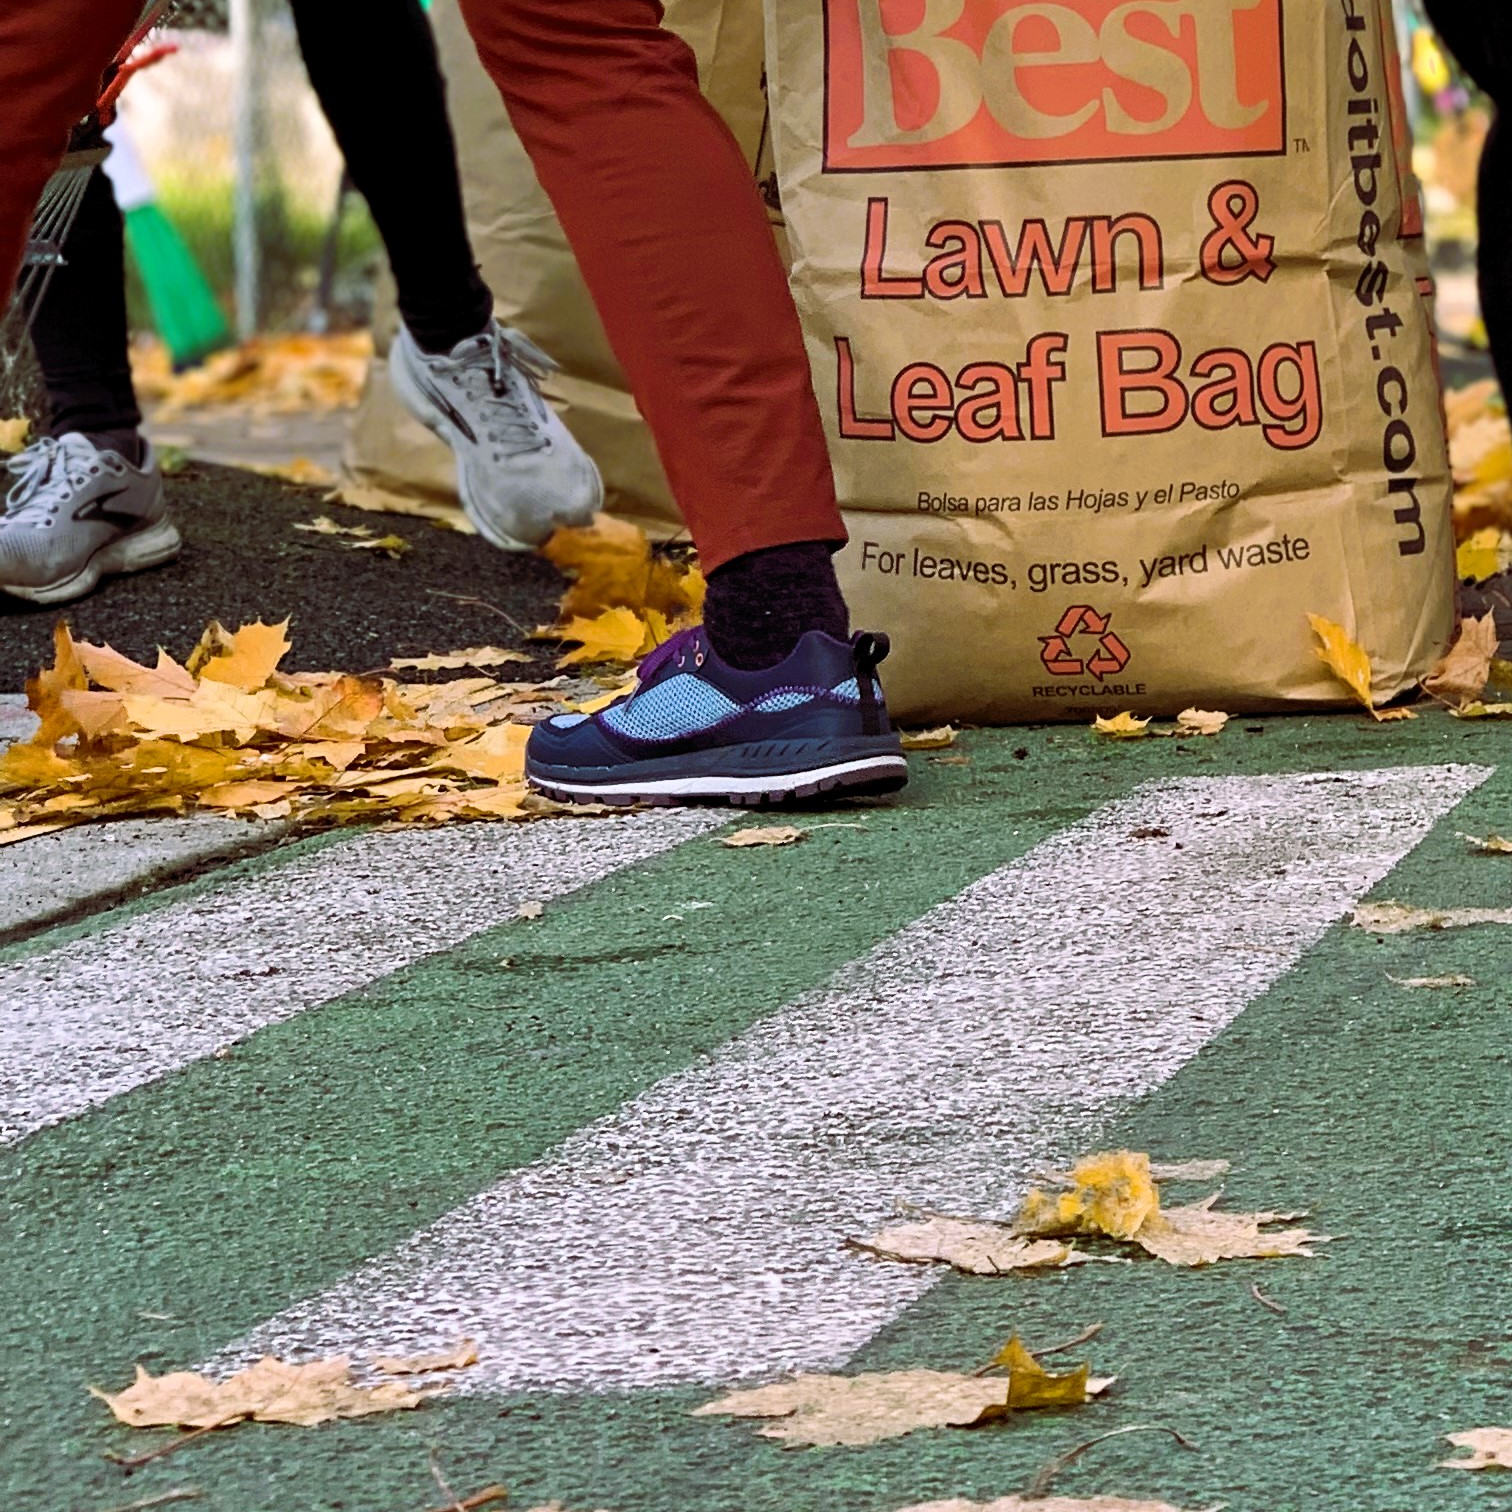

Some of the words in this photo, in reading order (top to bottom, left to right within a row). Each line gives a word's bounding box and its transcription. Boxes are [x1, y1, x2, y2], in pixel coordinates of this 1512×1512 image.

[860, 194, 1164, 300] Lawn
[1200, 179, 1277, 285] &
[833, 333, 1069, 444] Leaf
[1095, 328, 1323, 451] Bag
[917, 491, 969, 513] Bolsa
[975, 496, 1022, 516] para
[1028, 491, 1060, 512] las
[1065, 488, 1129, 514] Hojas
[1133, 490, 1149, 510] y
[1153, 483, 1173, 504] el
[1179, 479, 1241, 502] Pasto
[861, 541, 905, 575] For
[912, 548, 1018, 590] leaves,
[1027, 560, 1130, 593] grass,
[1138, 545, 1208, 589] yard
[1217, 534, 1311, 571] waste
[1032, 683, 1147, 697] RECYCLABLE
